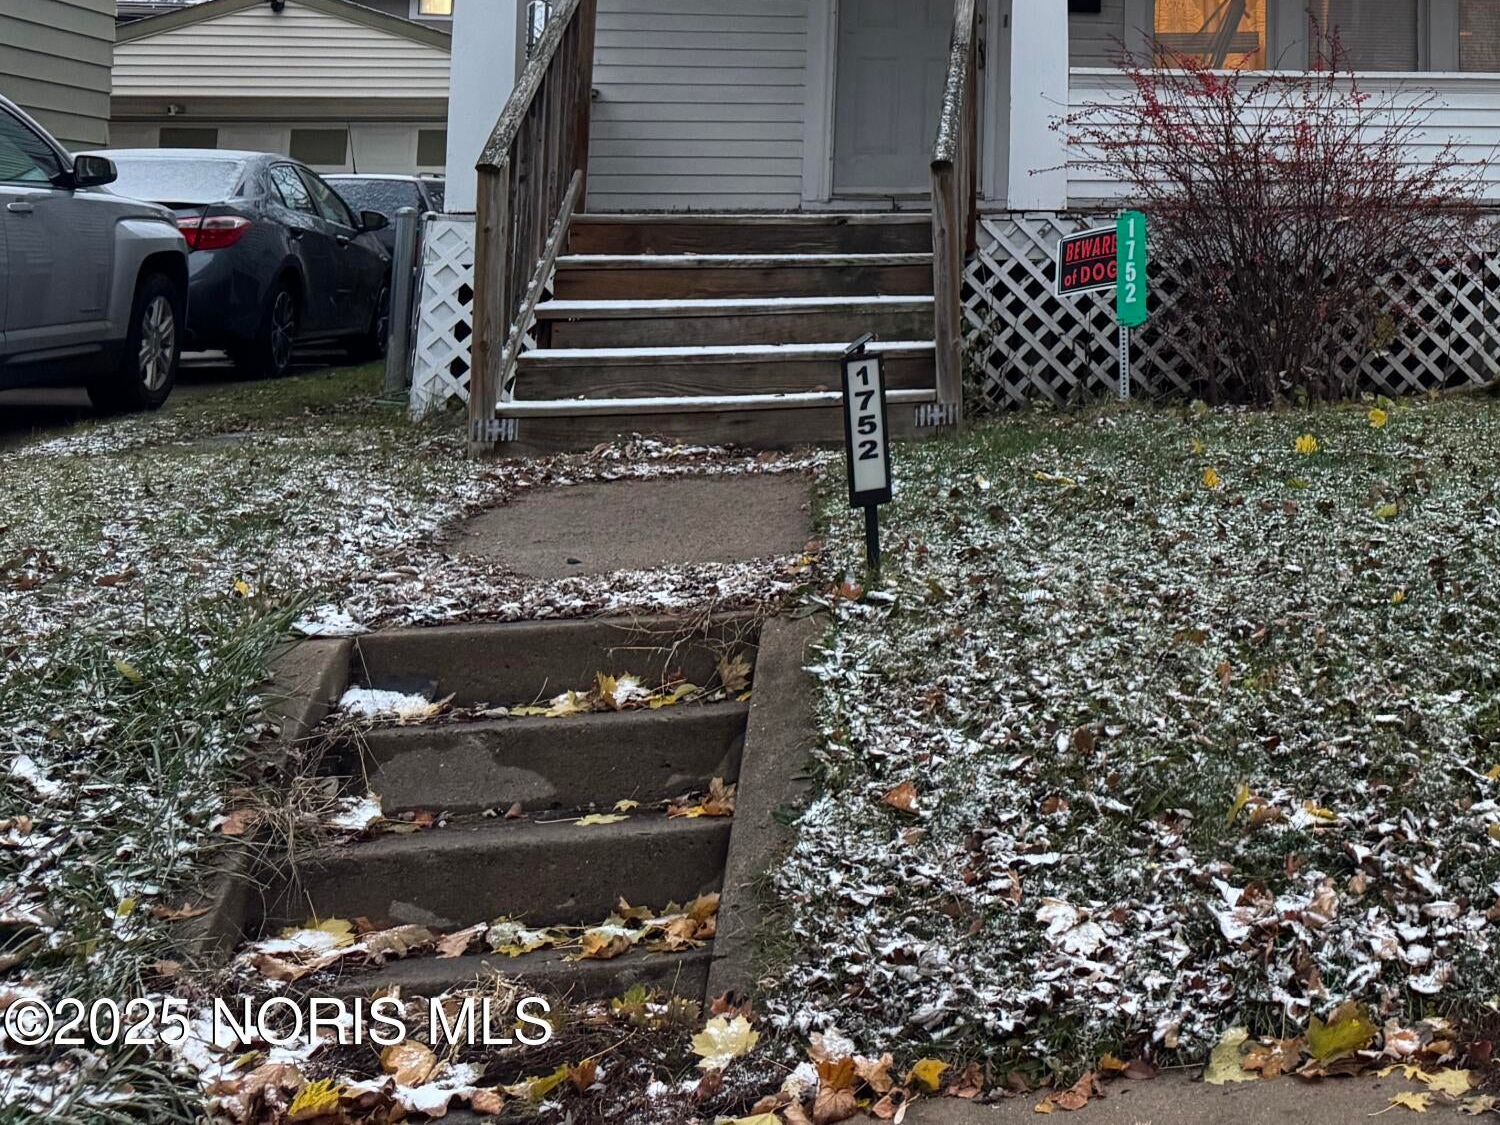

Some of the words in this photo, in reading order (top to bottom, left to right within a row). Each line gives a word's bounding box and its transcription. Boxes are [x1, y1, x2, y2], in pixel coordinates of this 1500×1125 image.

[1064, 268, 1078, 287] of
[1080, 260, 1117, 284] DOG
[1125, 218, 1137, 304] 1752
[854, 365, 879, 461] 1752
